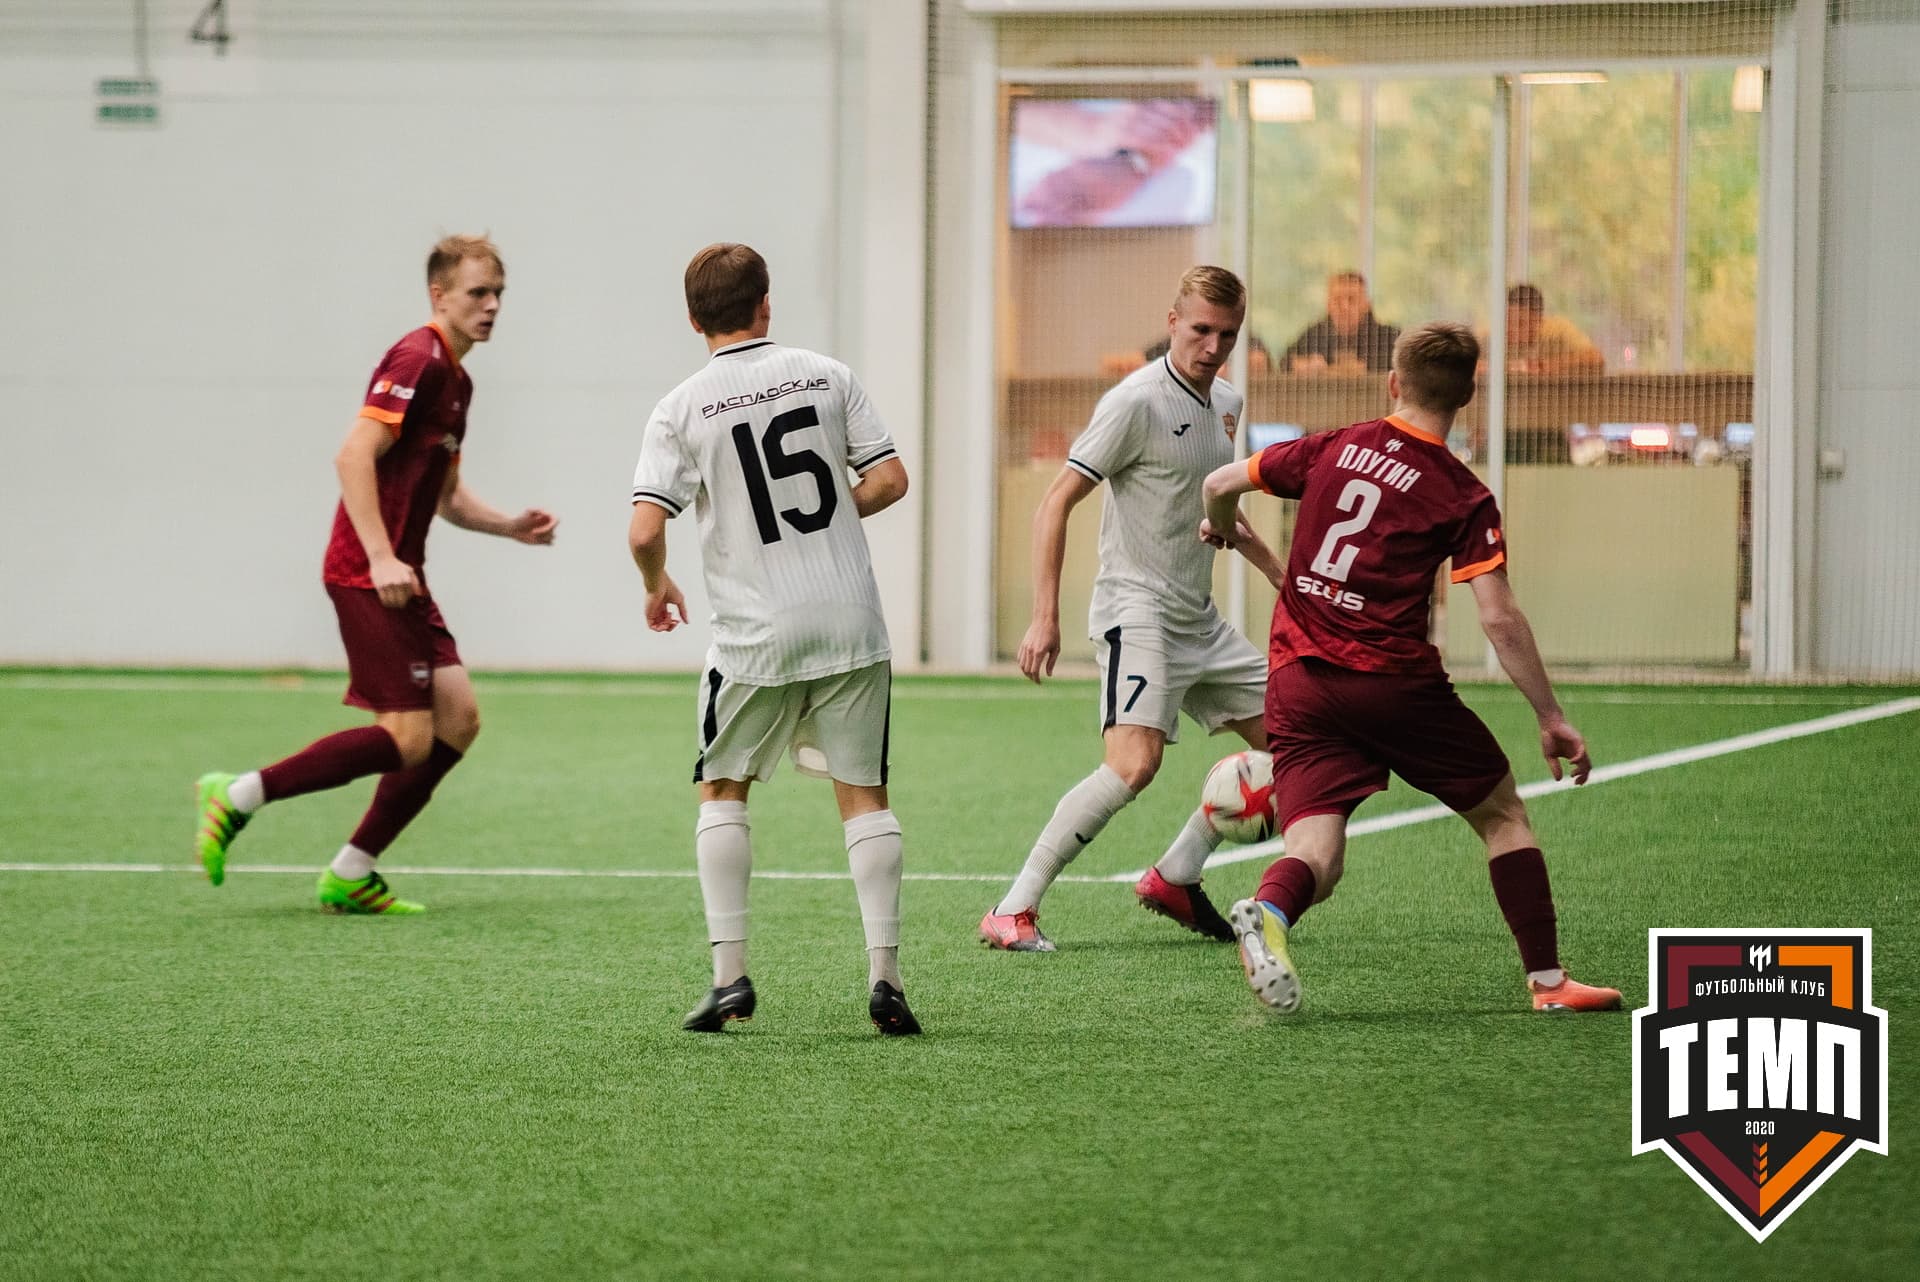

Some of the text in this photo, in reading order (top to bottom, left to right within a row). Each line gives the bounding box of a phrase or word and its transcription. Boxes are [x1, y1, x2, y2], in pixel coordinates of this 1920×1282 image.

[190, 0, 231, 57] 4
[731, 405, 838, 545] 15
[1336, 443, 1422, 493] ПЛУГИН
[1310, 479, 1382, 582] 2
[1123, 675, 1148, 712] 7
